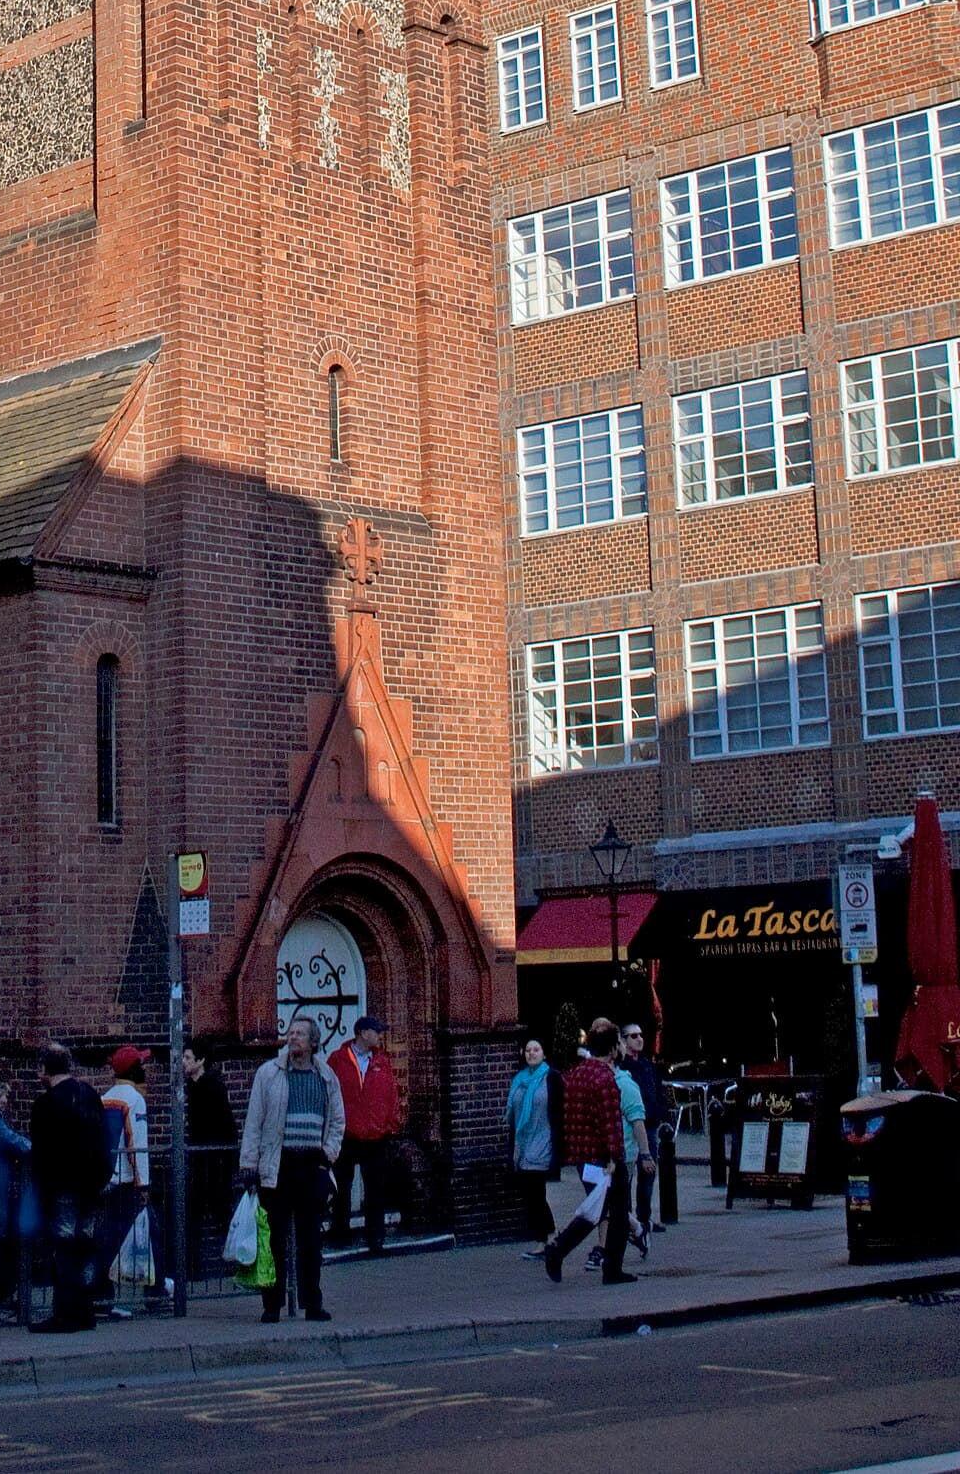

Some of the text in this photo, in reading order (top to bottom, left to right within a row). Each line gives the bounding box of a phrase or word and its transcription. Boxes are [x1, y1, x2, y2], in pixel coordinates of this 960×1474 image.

[845, 871, 867, 879] ZONE
[693, 900, 839, 940] La Tasca
[700, 941, 734, 956] SPANISH
[736, 941, 762, 954] TAPAS
[764, 941, 780, 953] BAR
